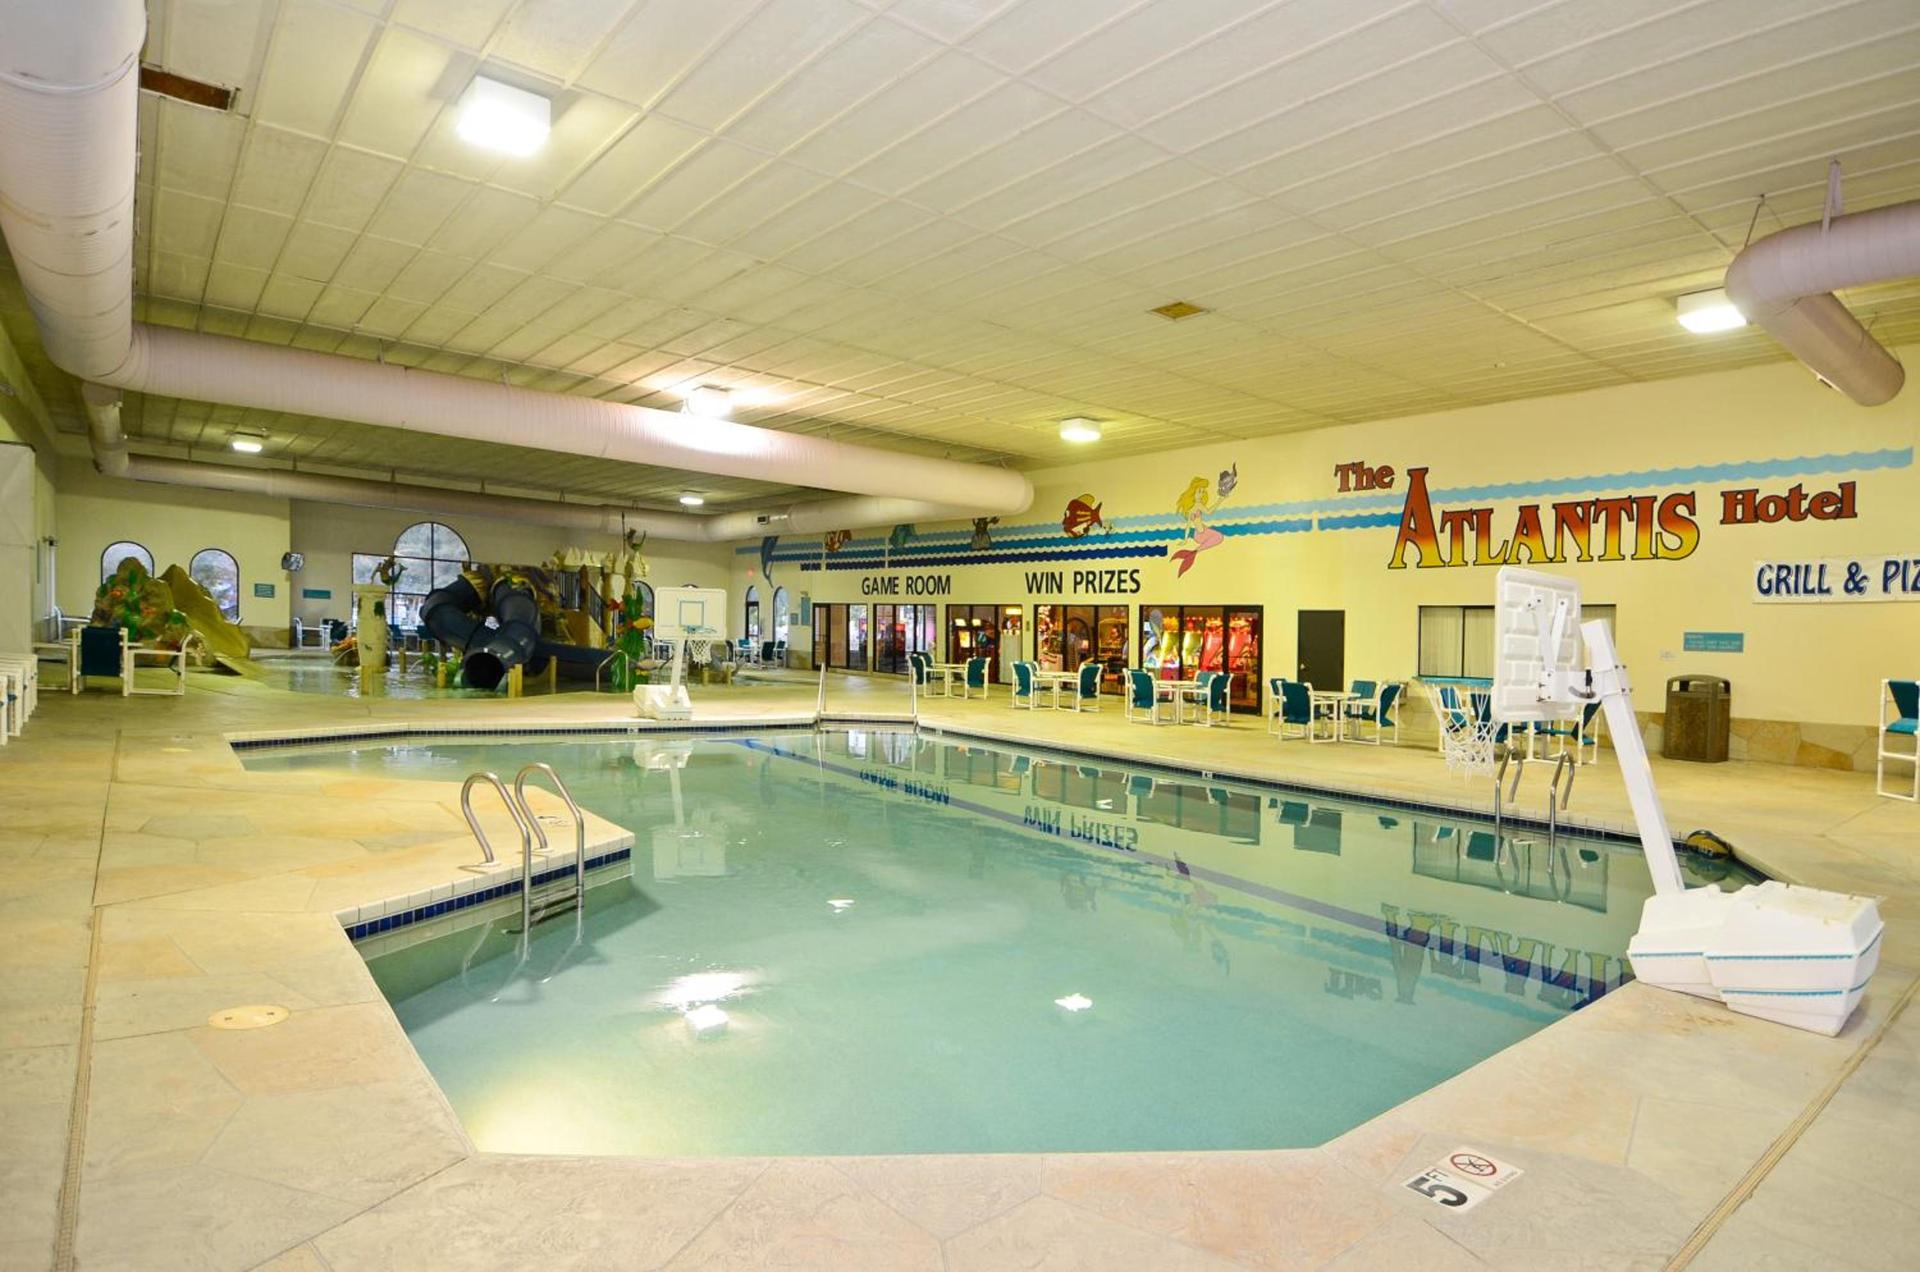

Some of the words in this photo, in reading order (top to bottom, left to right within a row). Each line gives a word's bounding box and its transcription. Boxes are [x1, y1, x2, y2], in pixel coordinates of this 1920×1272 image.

[1334, 461, 1395, 493] The
[1387, 466, 1700, 569] ATLANTIS
[1720, 481, 1858, 525] Hotel
[862, 576, 900, 596] GAME
[905, 574, 951, 596] ROOM
[1025, 571, 1063, 595] WIN
[1073, 568, 1141, 595] PRIZES
[1756, 563, 1832, 596] GRILL
[1843, 561, 1869, 595] &
[1406, 1176, 1468, 1207] 5
